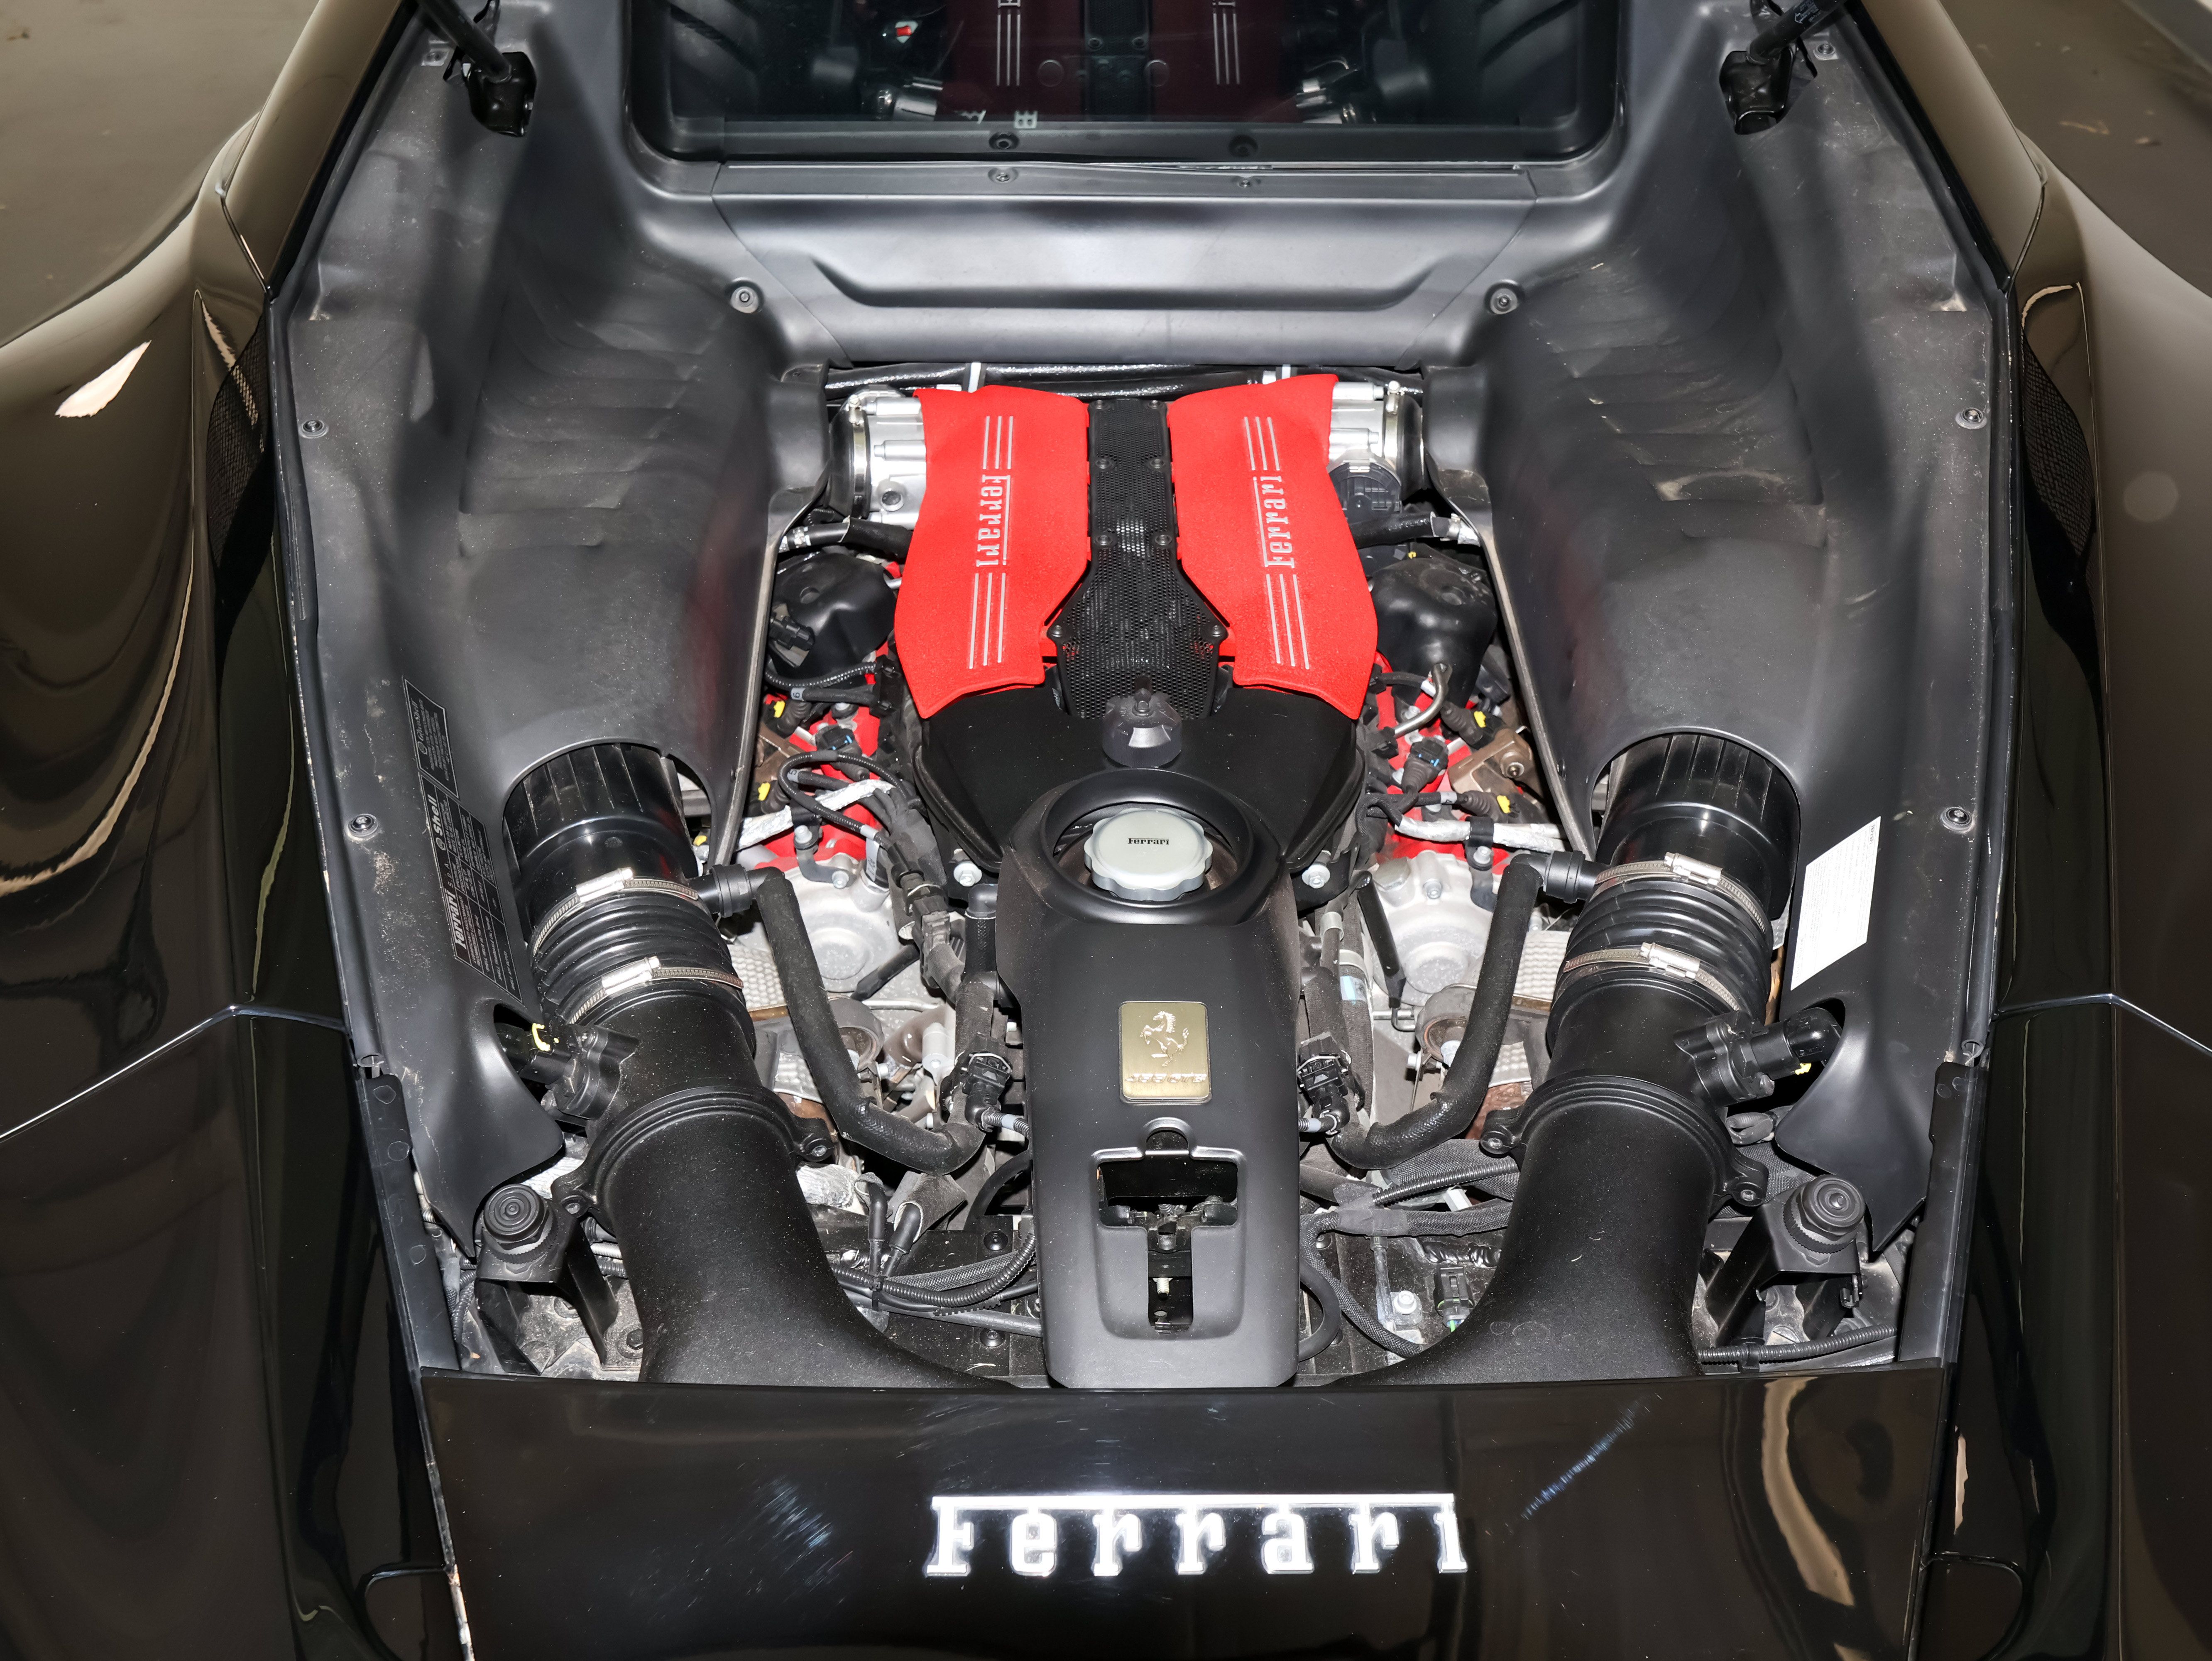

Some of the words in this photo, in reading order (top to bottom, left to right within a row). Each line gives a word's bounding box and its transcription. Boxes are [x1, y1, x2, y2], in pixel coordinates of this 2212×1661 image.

[976, 474, 1011, 567] Ferrari
[1253, 475, 1295, 568] Ferrari
[428, 794, 443, 836] Shell
[1127, 837, 1170, 846] Ferrari
[445, 890, 466, 950] Ferrari
[925, 1492, 1469, 1577] Ferrari
